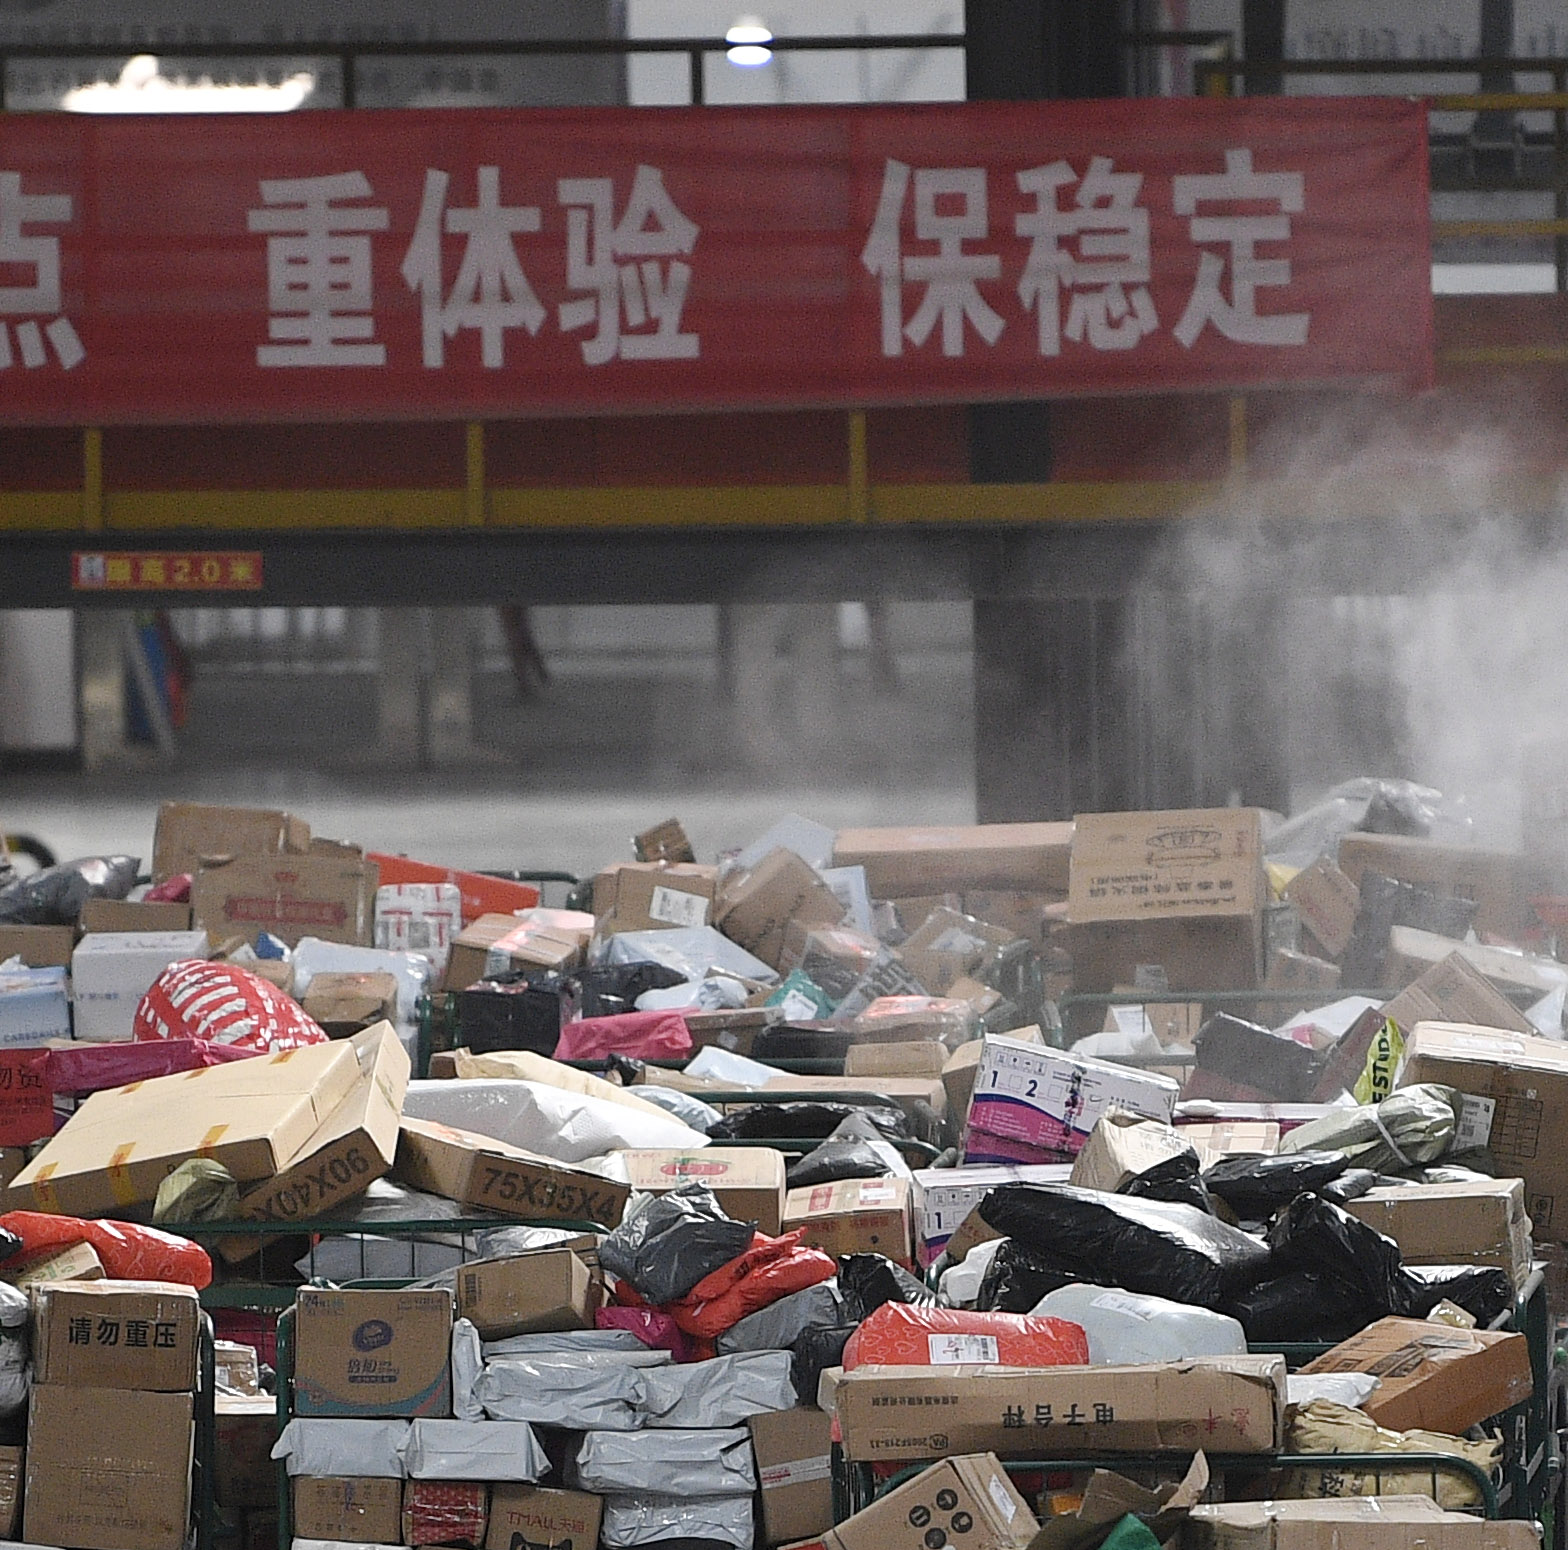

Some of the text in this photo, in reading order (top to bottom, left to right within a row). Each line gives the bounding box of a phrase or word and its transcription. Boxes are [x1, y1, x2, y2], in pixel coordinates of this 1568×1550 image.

[246, 162, 703, 371] 重体验
[862, 146, 1313, 362] 保稳定
[990, 1069, 999, 1089] 1
[1024, 1078, 1039, 1098] 2
[482, 1166, 616, 1221] 75X35X4
[934, 1211, 942, 1230] 1
[68, 1316, 178, 1348] 请勿重压
[1001, 1402, 1114, 1429] 电子台秤
